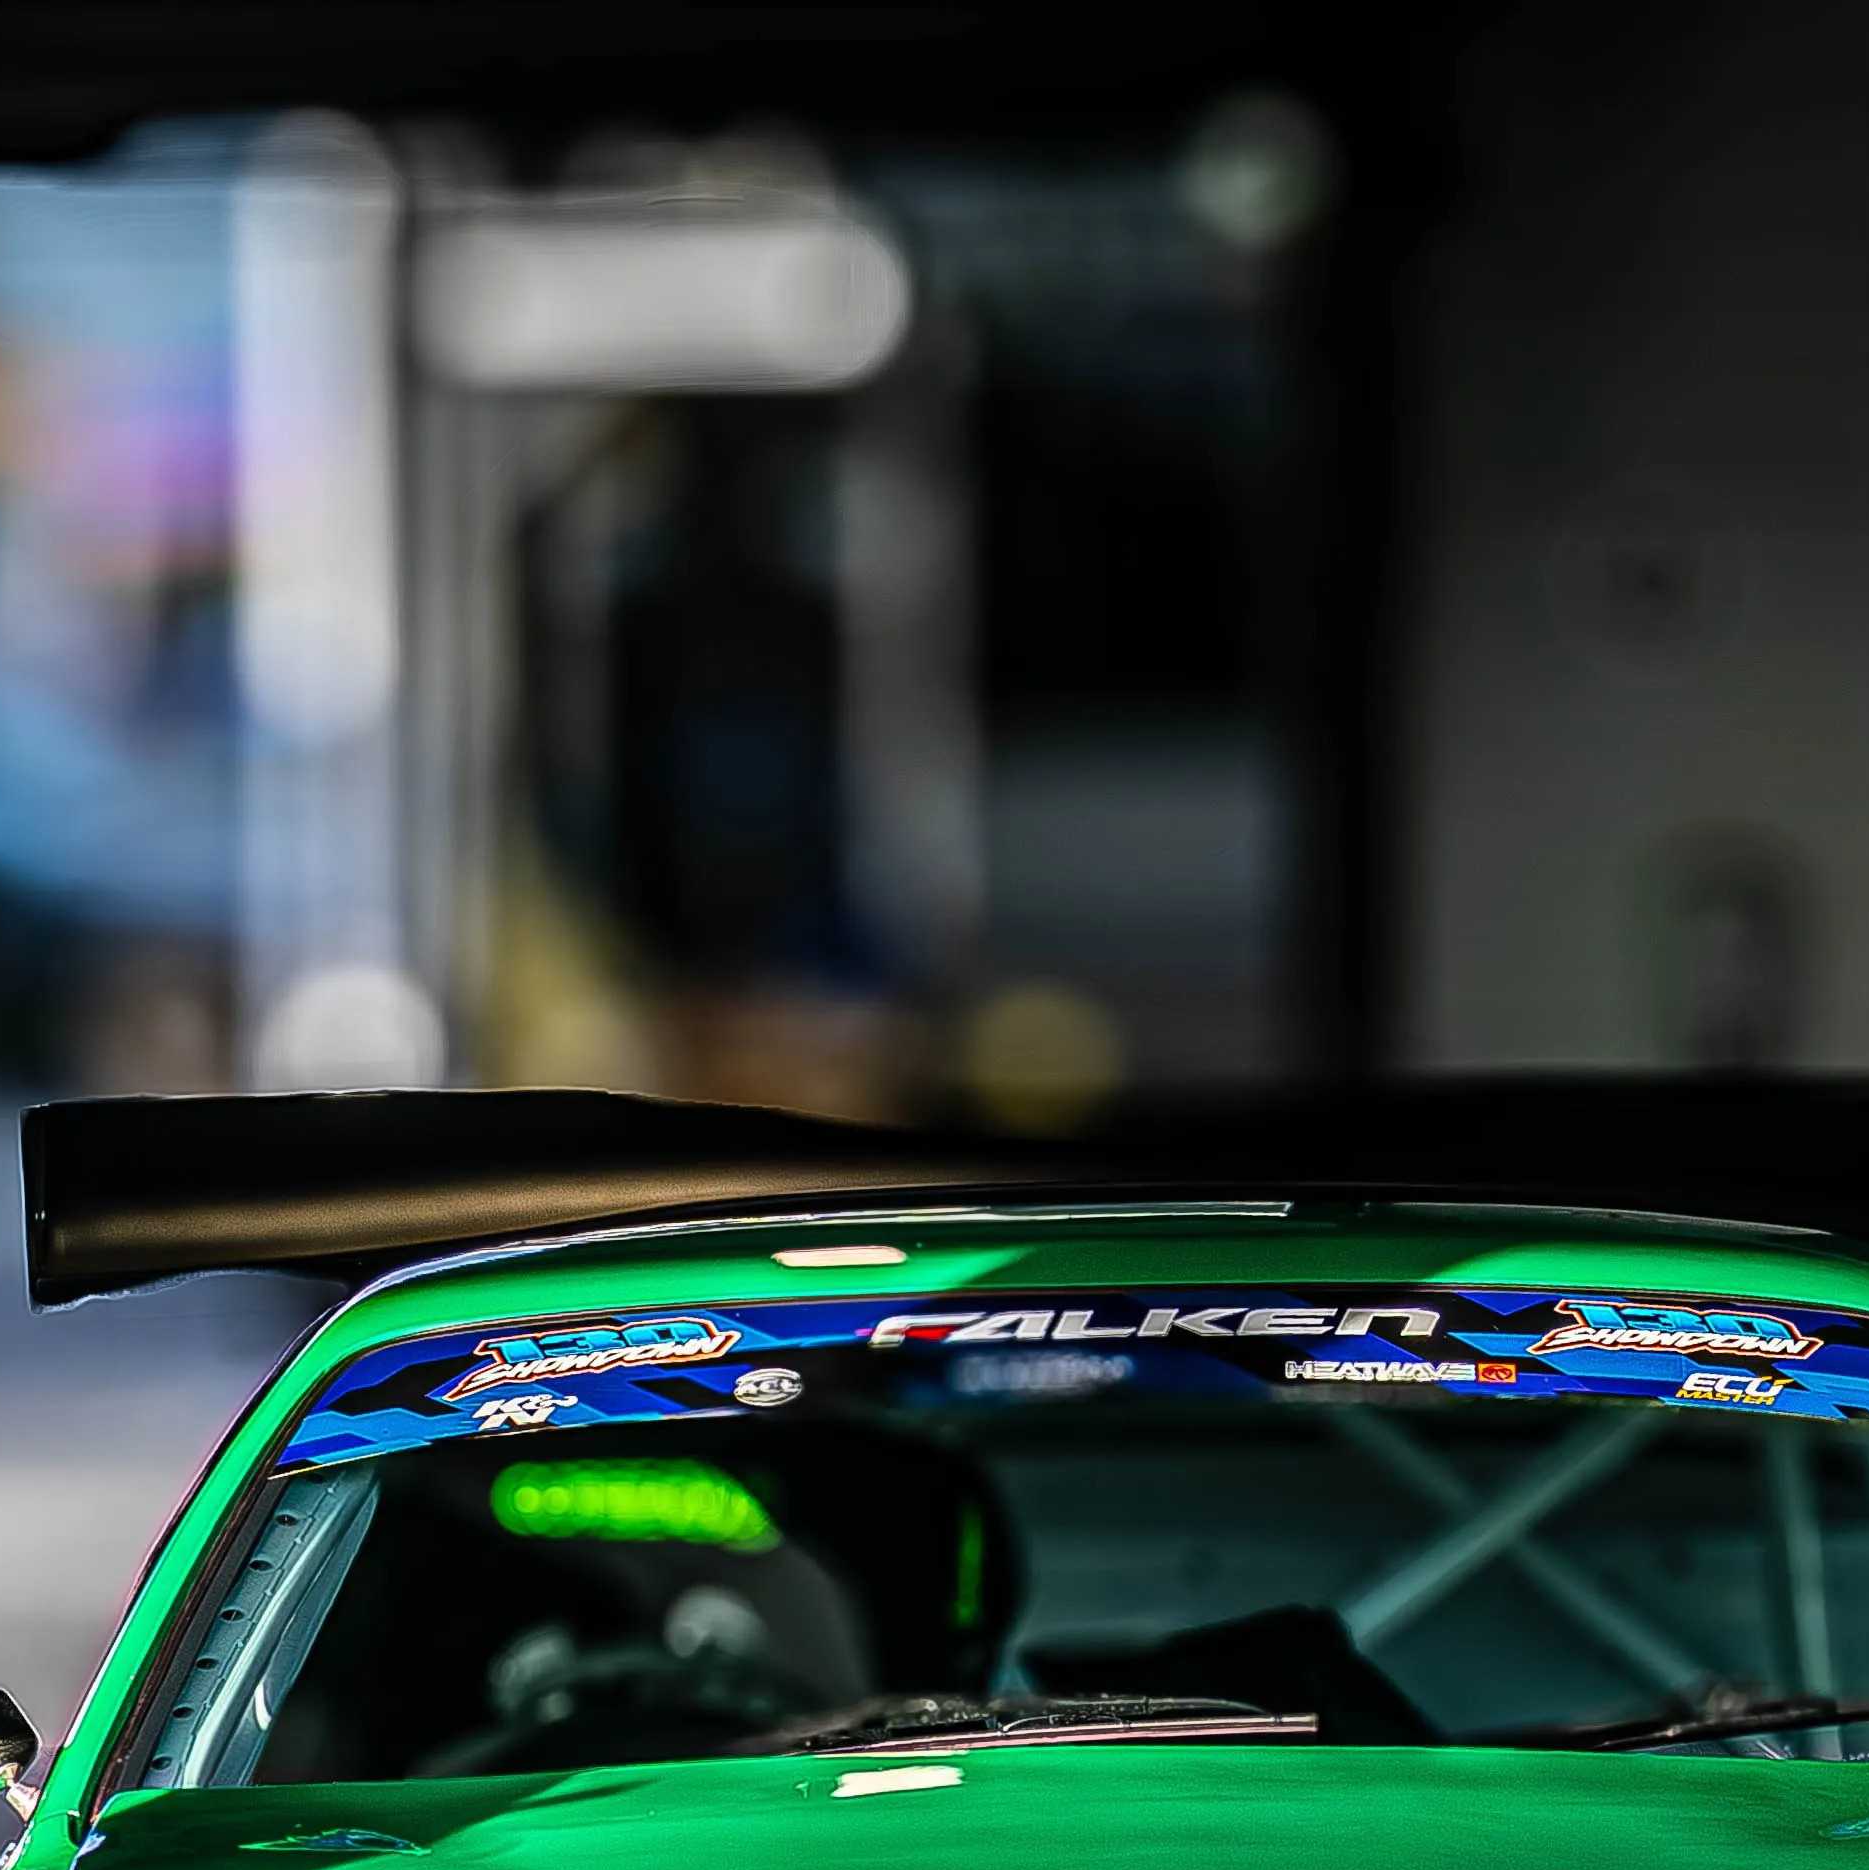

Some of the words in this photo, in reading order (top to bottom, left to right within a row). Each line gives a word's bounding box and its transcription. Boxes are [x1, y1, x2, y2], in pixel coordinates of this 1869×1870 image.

[868, 1306, 1443, 1348] FALKEN
[1567, 1303, 1792, 1339] 130
[488, 1321, 712, 1365] 130
[1546, 1327, 1809, 1354] SHOWDOWN
[463, 1334, 727, 1390] SHOWDOWN
[1285, 1360, 1476, 1382] HEATWAVE
[1676, 1388, 1777, 1406] MASTER
[1682, 1372, 1790, 1398] ECU
